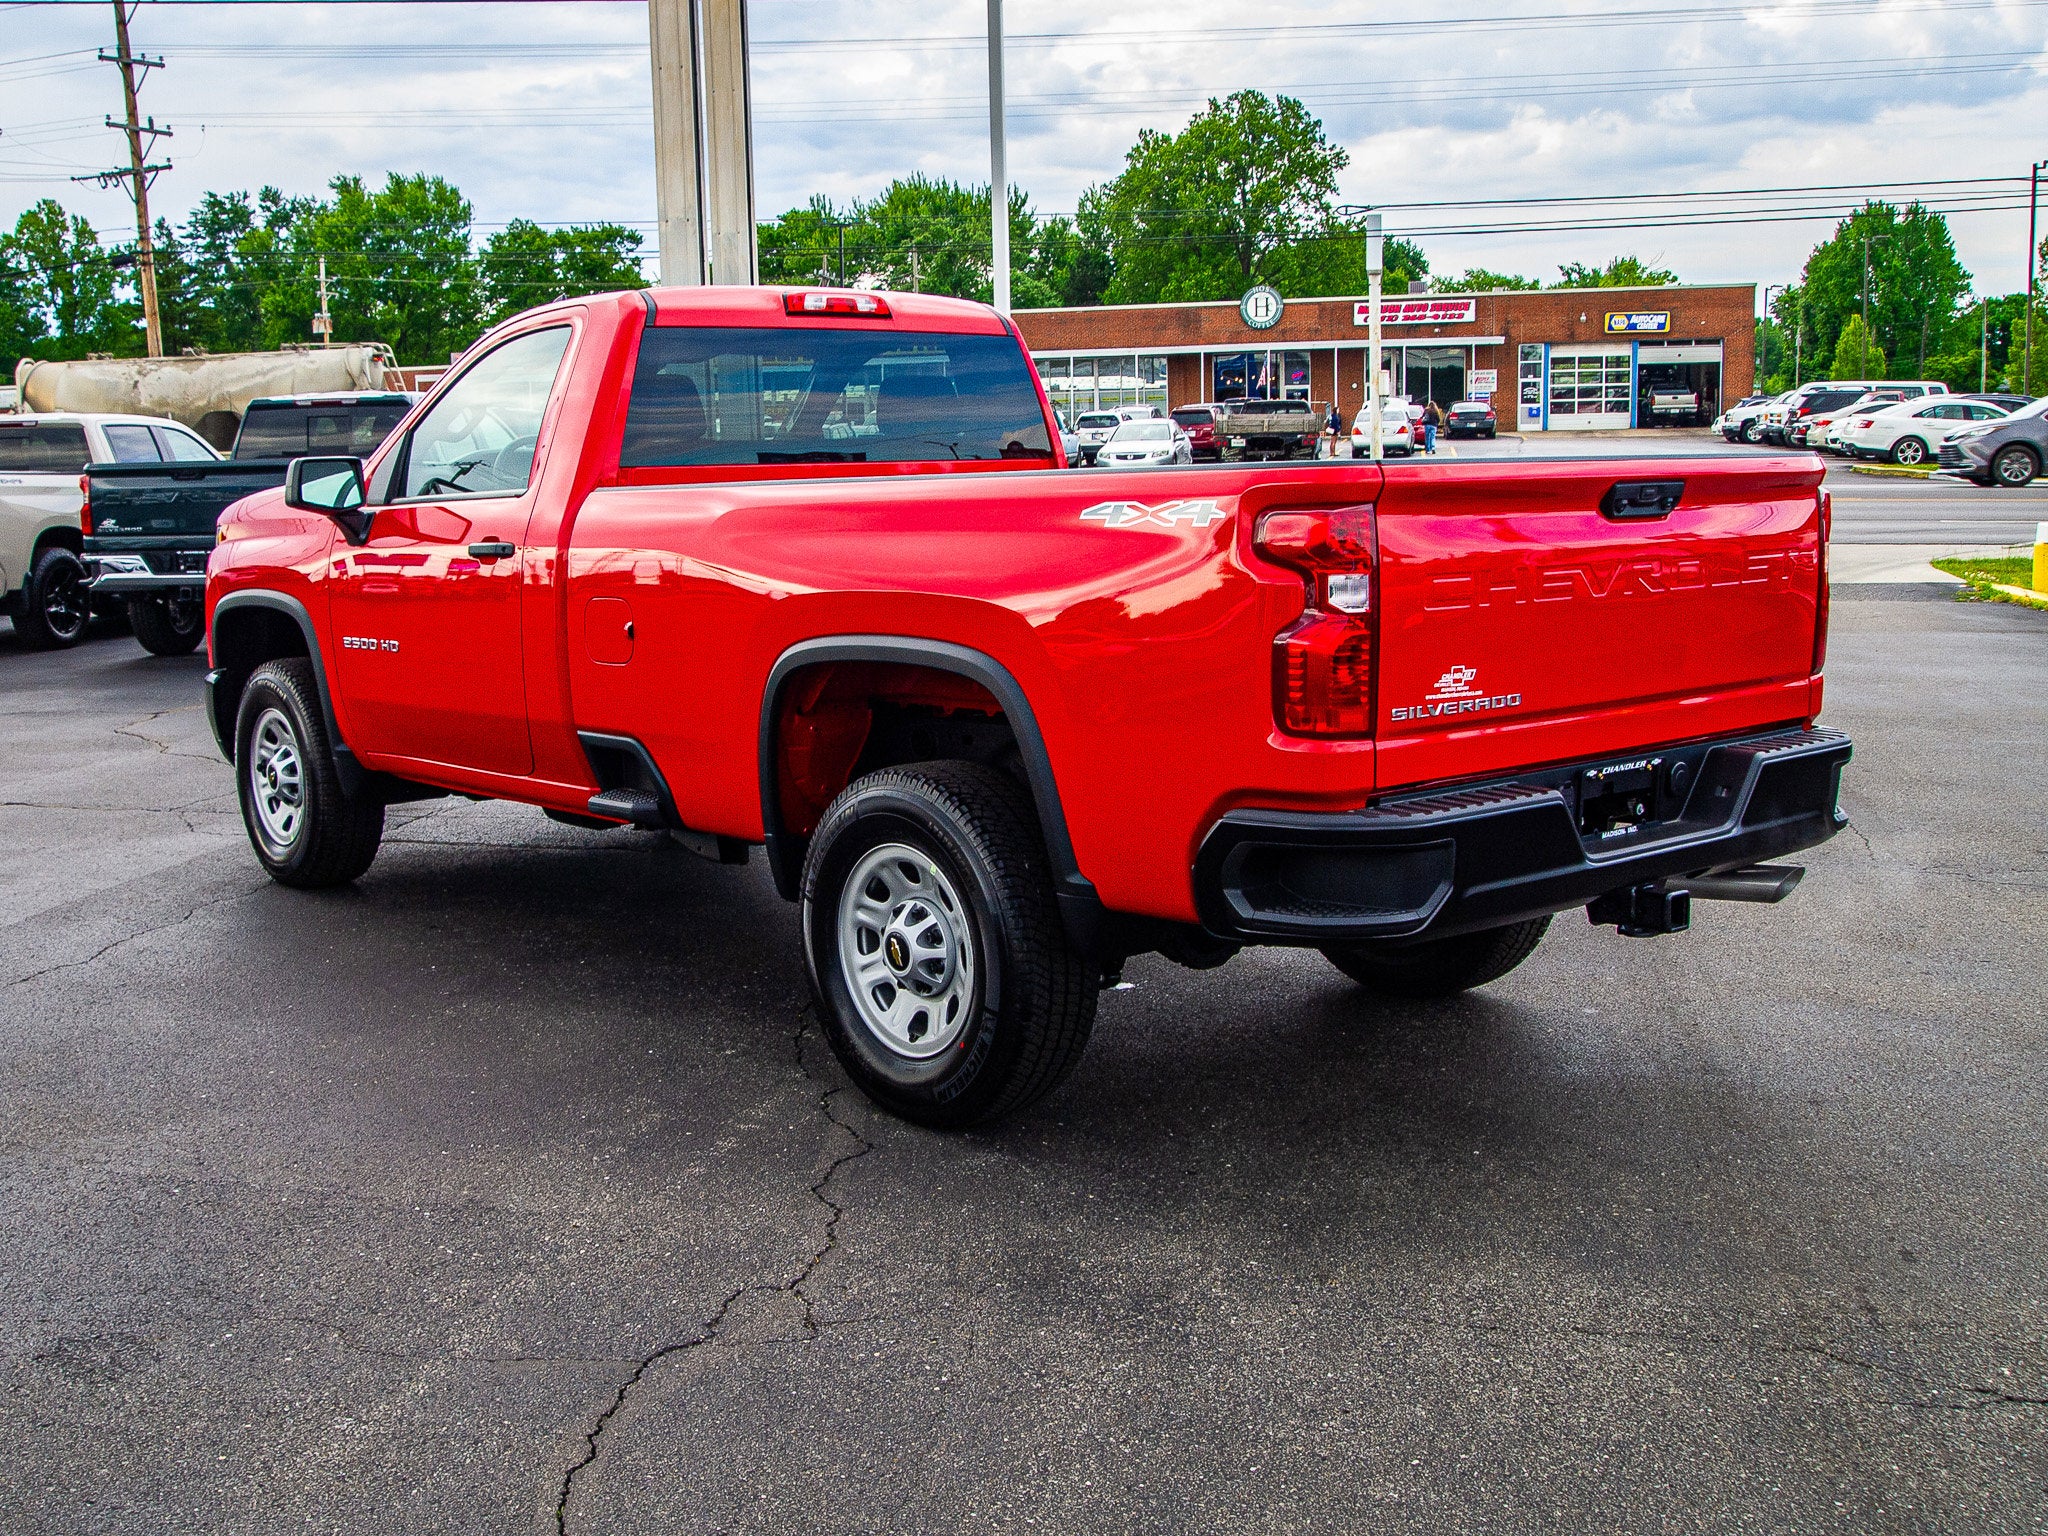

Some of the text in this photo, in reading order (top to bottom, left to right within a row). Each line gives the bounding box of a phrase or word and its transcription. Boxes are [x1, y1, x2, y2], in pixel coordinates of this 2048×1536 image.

[1402, 303, 1428, 314] AUTO
[1429, 301, 1471, 312] SERVICE
[1079, 500, 1227, 528] 4X4
[1424, 550, 1818, 611] CHEVROLET
[342, 636, 400, 653] 2500 HD
[1391, 693, 1522, 722] SILVERADO
[1602, 760, 1648, 775] CHANDLER
